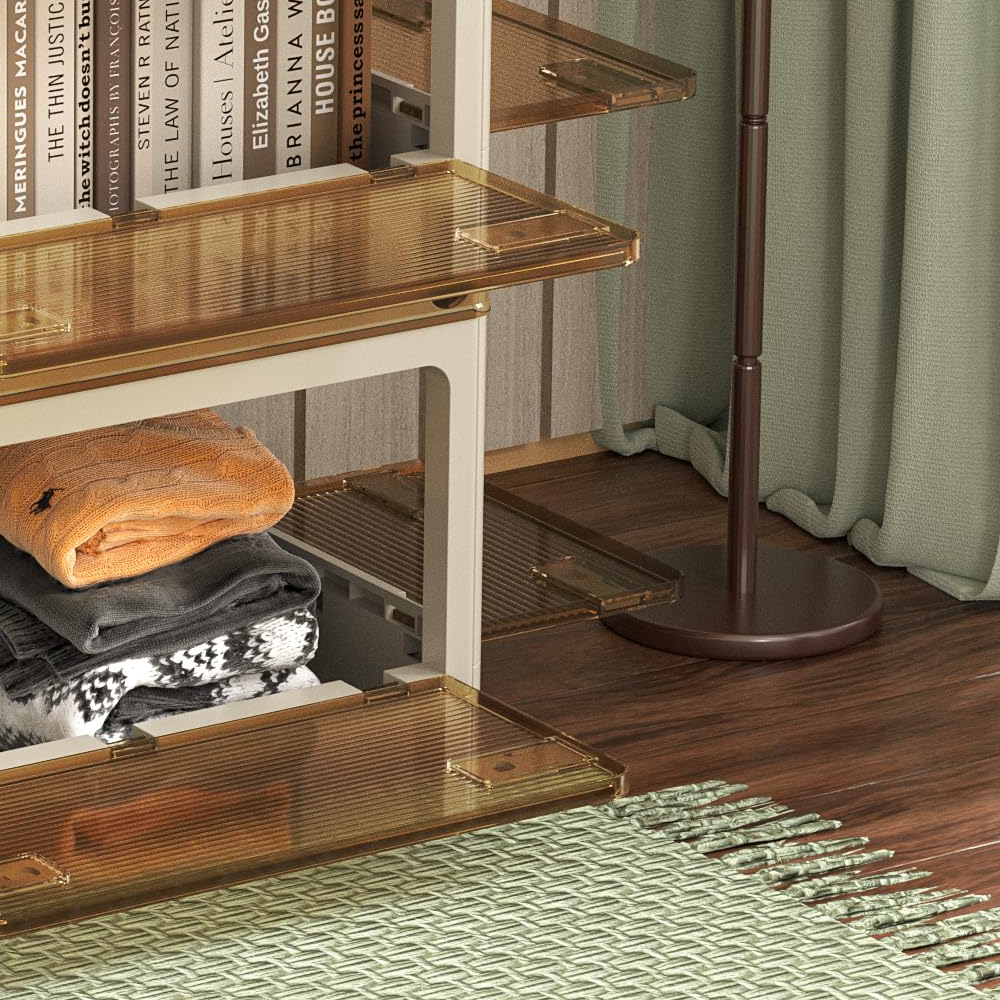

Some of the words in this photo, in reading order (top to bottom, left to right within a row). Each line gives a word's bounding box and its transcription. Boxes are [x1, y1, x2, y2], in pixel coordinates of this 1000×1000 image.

[79, 31, 91, 112] doesn't
[138, 55, 150, 67] R
[165, 61, 179, 88] OF
[315, 31, 335, 115] HOUSE
[350, 24, 366, 120] princess
[48, 73, 65, 119] THIN
[109, 85, 120, 101] BY
[138, 76, 150, 150] STEVEN
[164, 98, 179, 141] LAW
[252, 48, 269, 150] Elizabeth
[286, 33, 303, 168] BRIANNA
[14, 85, 27, 213] MERINGUES
[48, 124, 64, 163] THE
[78, 115, 91, 176] witch
[211, 89, 233, 181] Houses
[349, 123, 363, 162] the
[164, 151, 179, 194] THE
